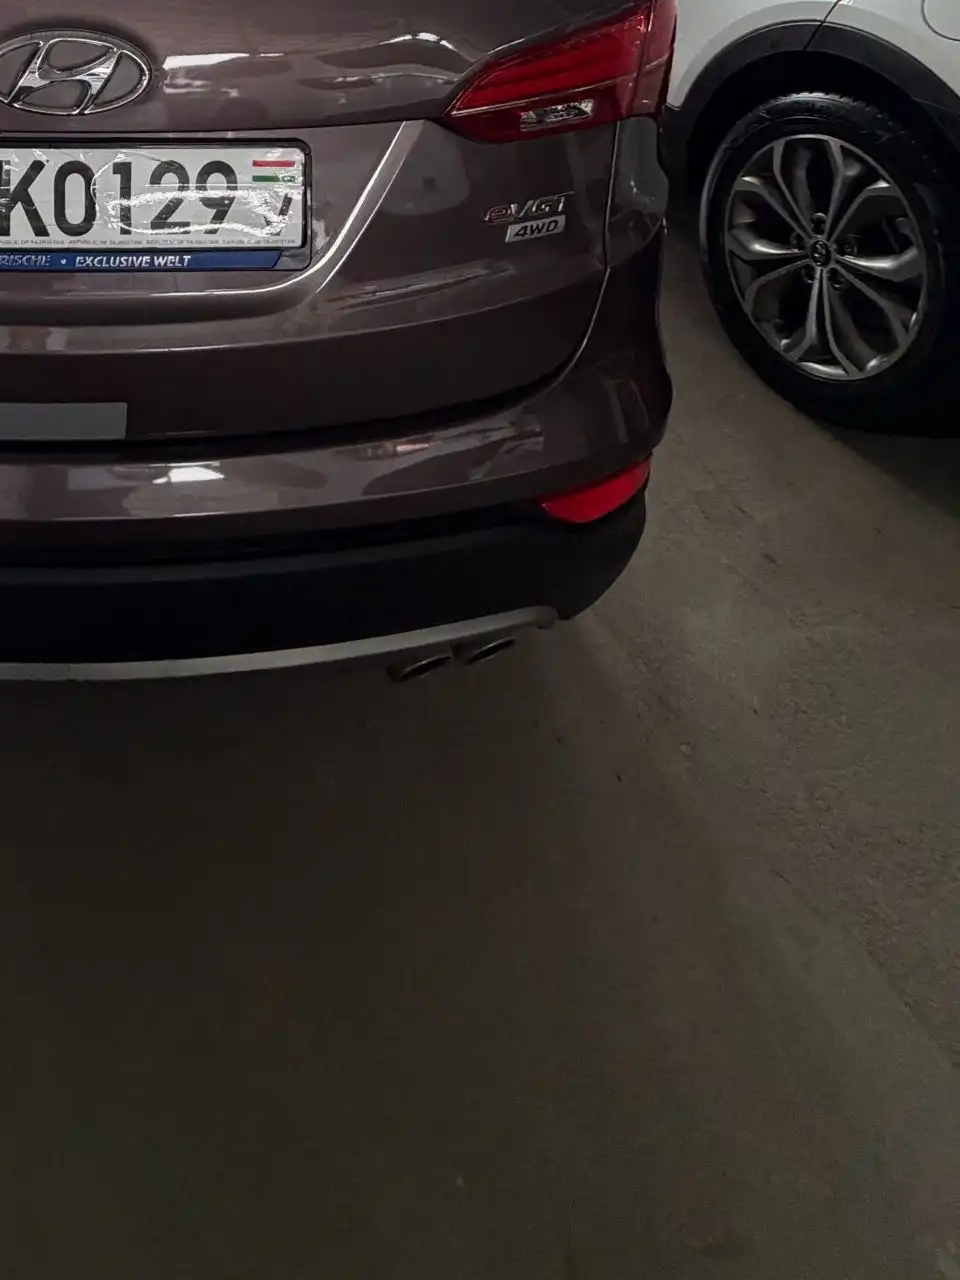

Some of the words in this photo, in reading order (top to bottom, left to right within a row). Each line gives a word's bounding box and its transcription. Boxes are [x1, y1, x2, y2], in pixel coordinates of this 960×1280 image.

[515, 220, 559, 238] 4WD
[75, 255, 150, 267] EXCLUSIVE
[153, 255, 191, 267] WELT
